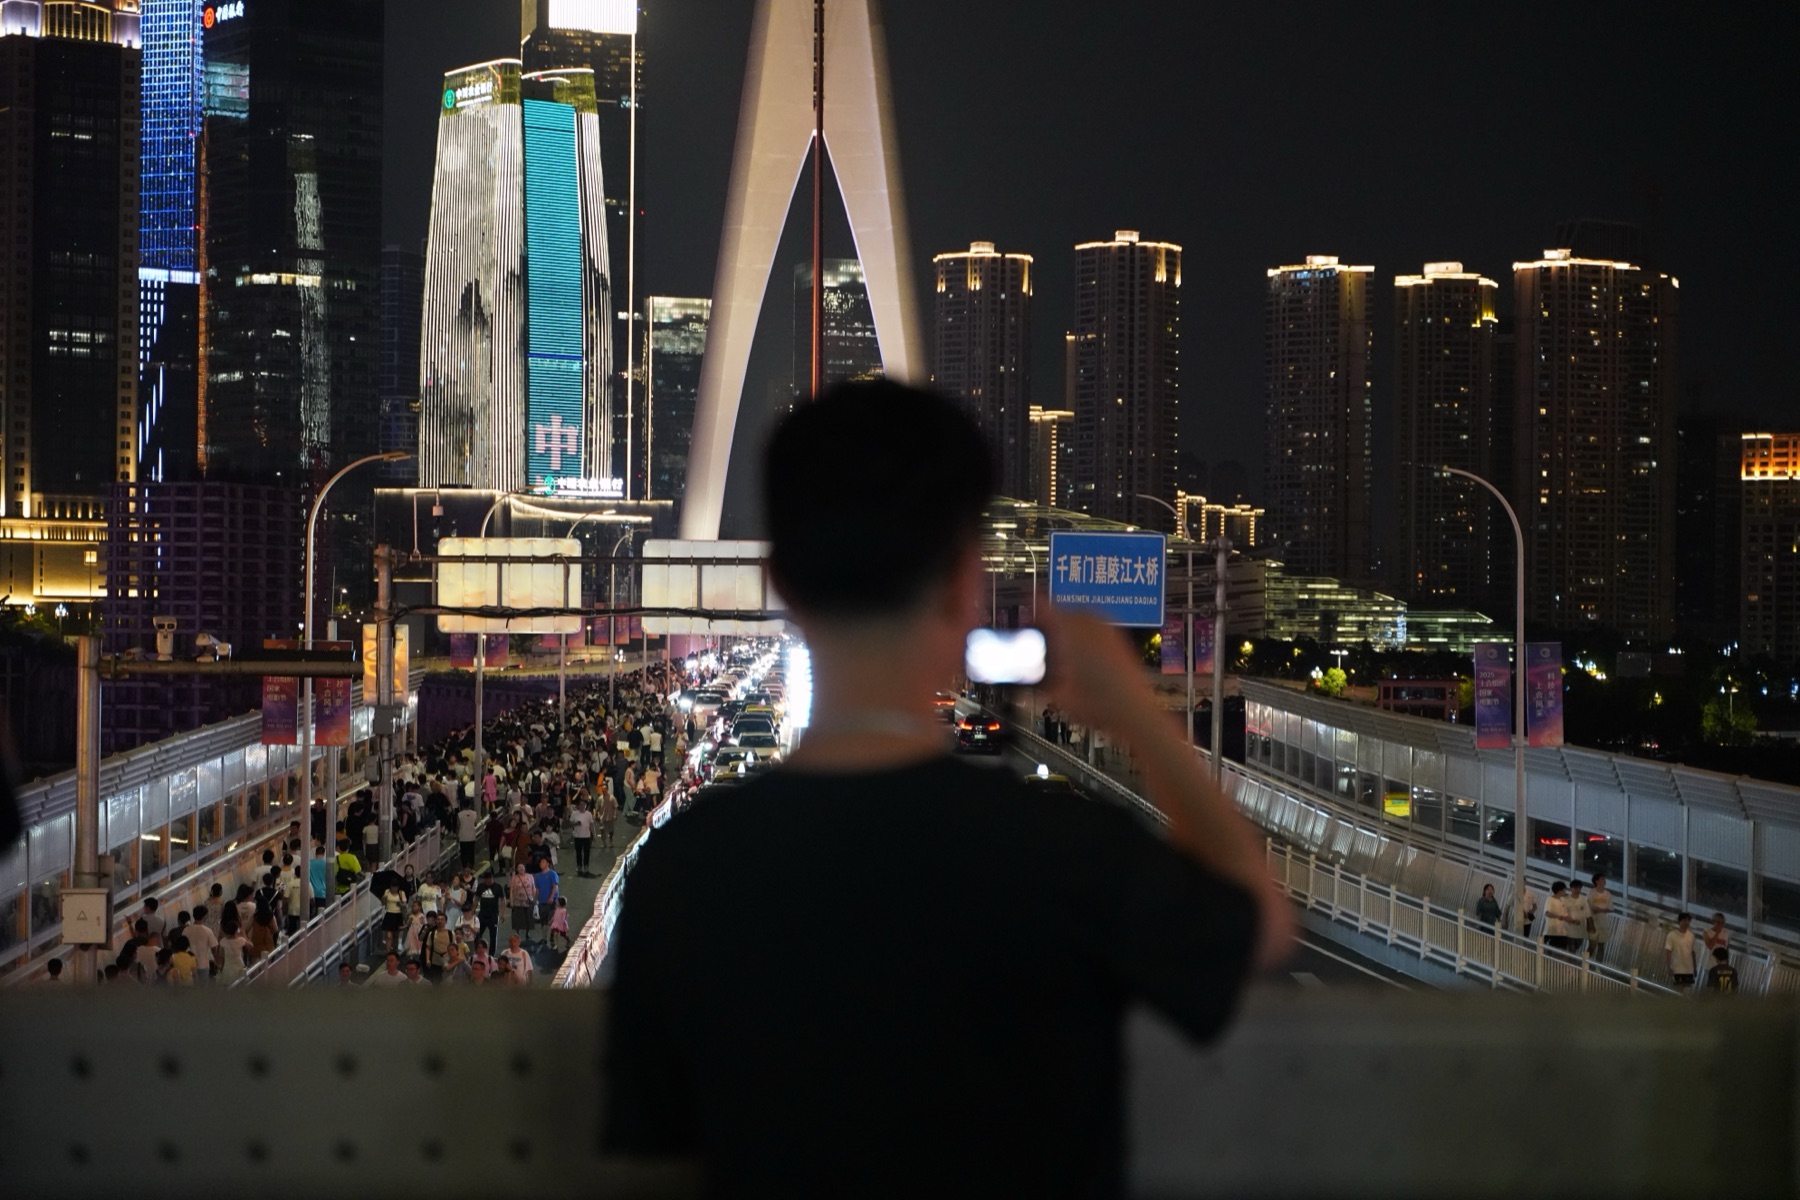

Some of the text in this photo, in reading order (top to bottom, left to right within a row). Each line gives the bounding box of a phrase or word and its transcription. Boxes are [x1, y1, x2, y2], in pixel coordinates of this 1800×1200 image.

[1056, 554, 1159, 586] 千厮门嘉陵江大桥
[1056, 594, 1158, 605] QIANSIMEN JIALINGJIANG DAQIAO
